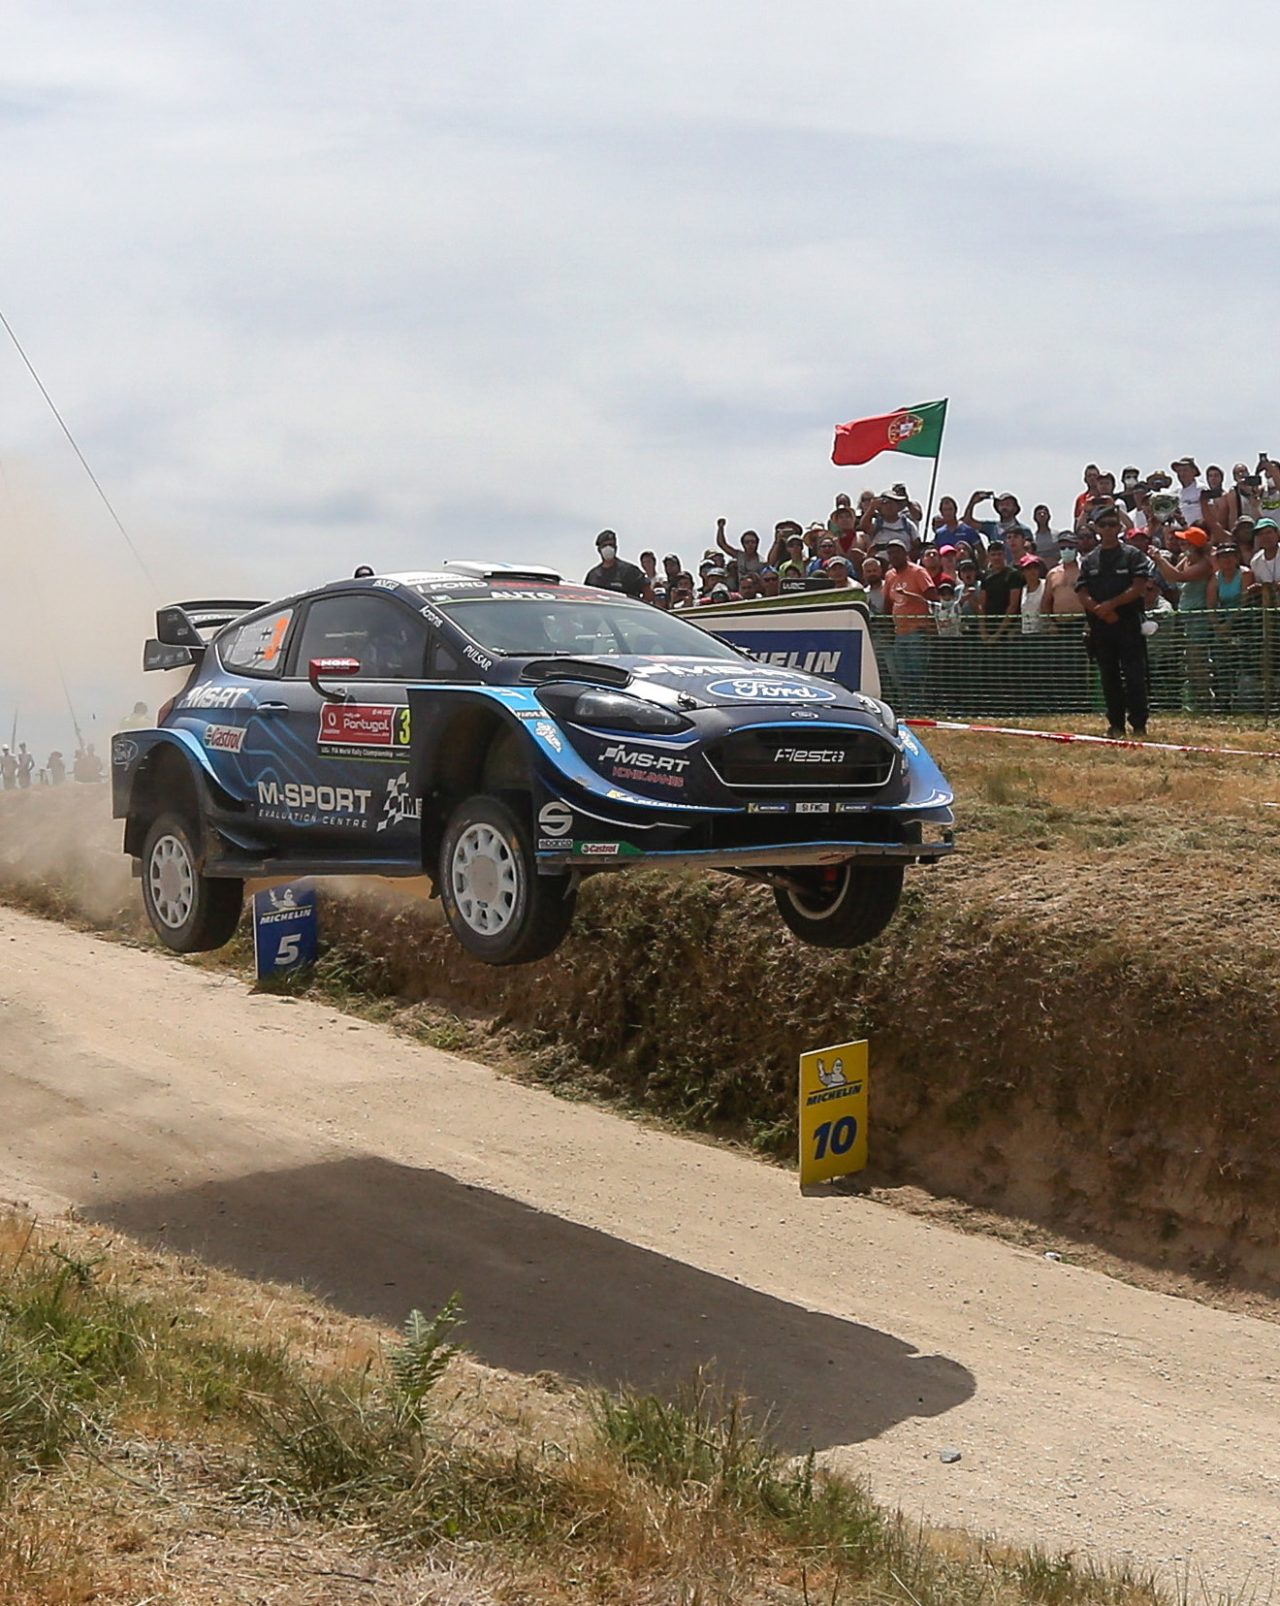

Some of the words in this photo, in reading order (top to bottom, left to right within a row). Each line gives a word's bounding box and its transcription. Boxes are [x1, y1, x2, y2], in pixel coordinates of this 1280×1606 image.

[782, 581, 806, 591] WRC
[462, 645, 492, 671] PULSAR
[732, 679, 818, 698] Ford
[343, 719, 389, 733] Portugal
[399, 708, 410, 744] 3
[211, 727, 242, 749] Castrol
[774, 748, 845, 763] Fiesta
[258, 809, 317, 823] EVALUATION
[322, 816, 368, 828] CENTRE
[588, 844, 617, 853] Castrol
[260, 909, 312, 925] MICHELIN
[274, 933, 302, 966] 5
[806, 1084, 863, 1107] MICHELIN
[813, 1115, 858, 1161] 10
